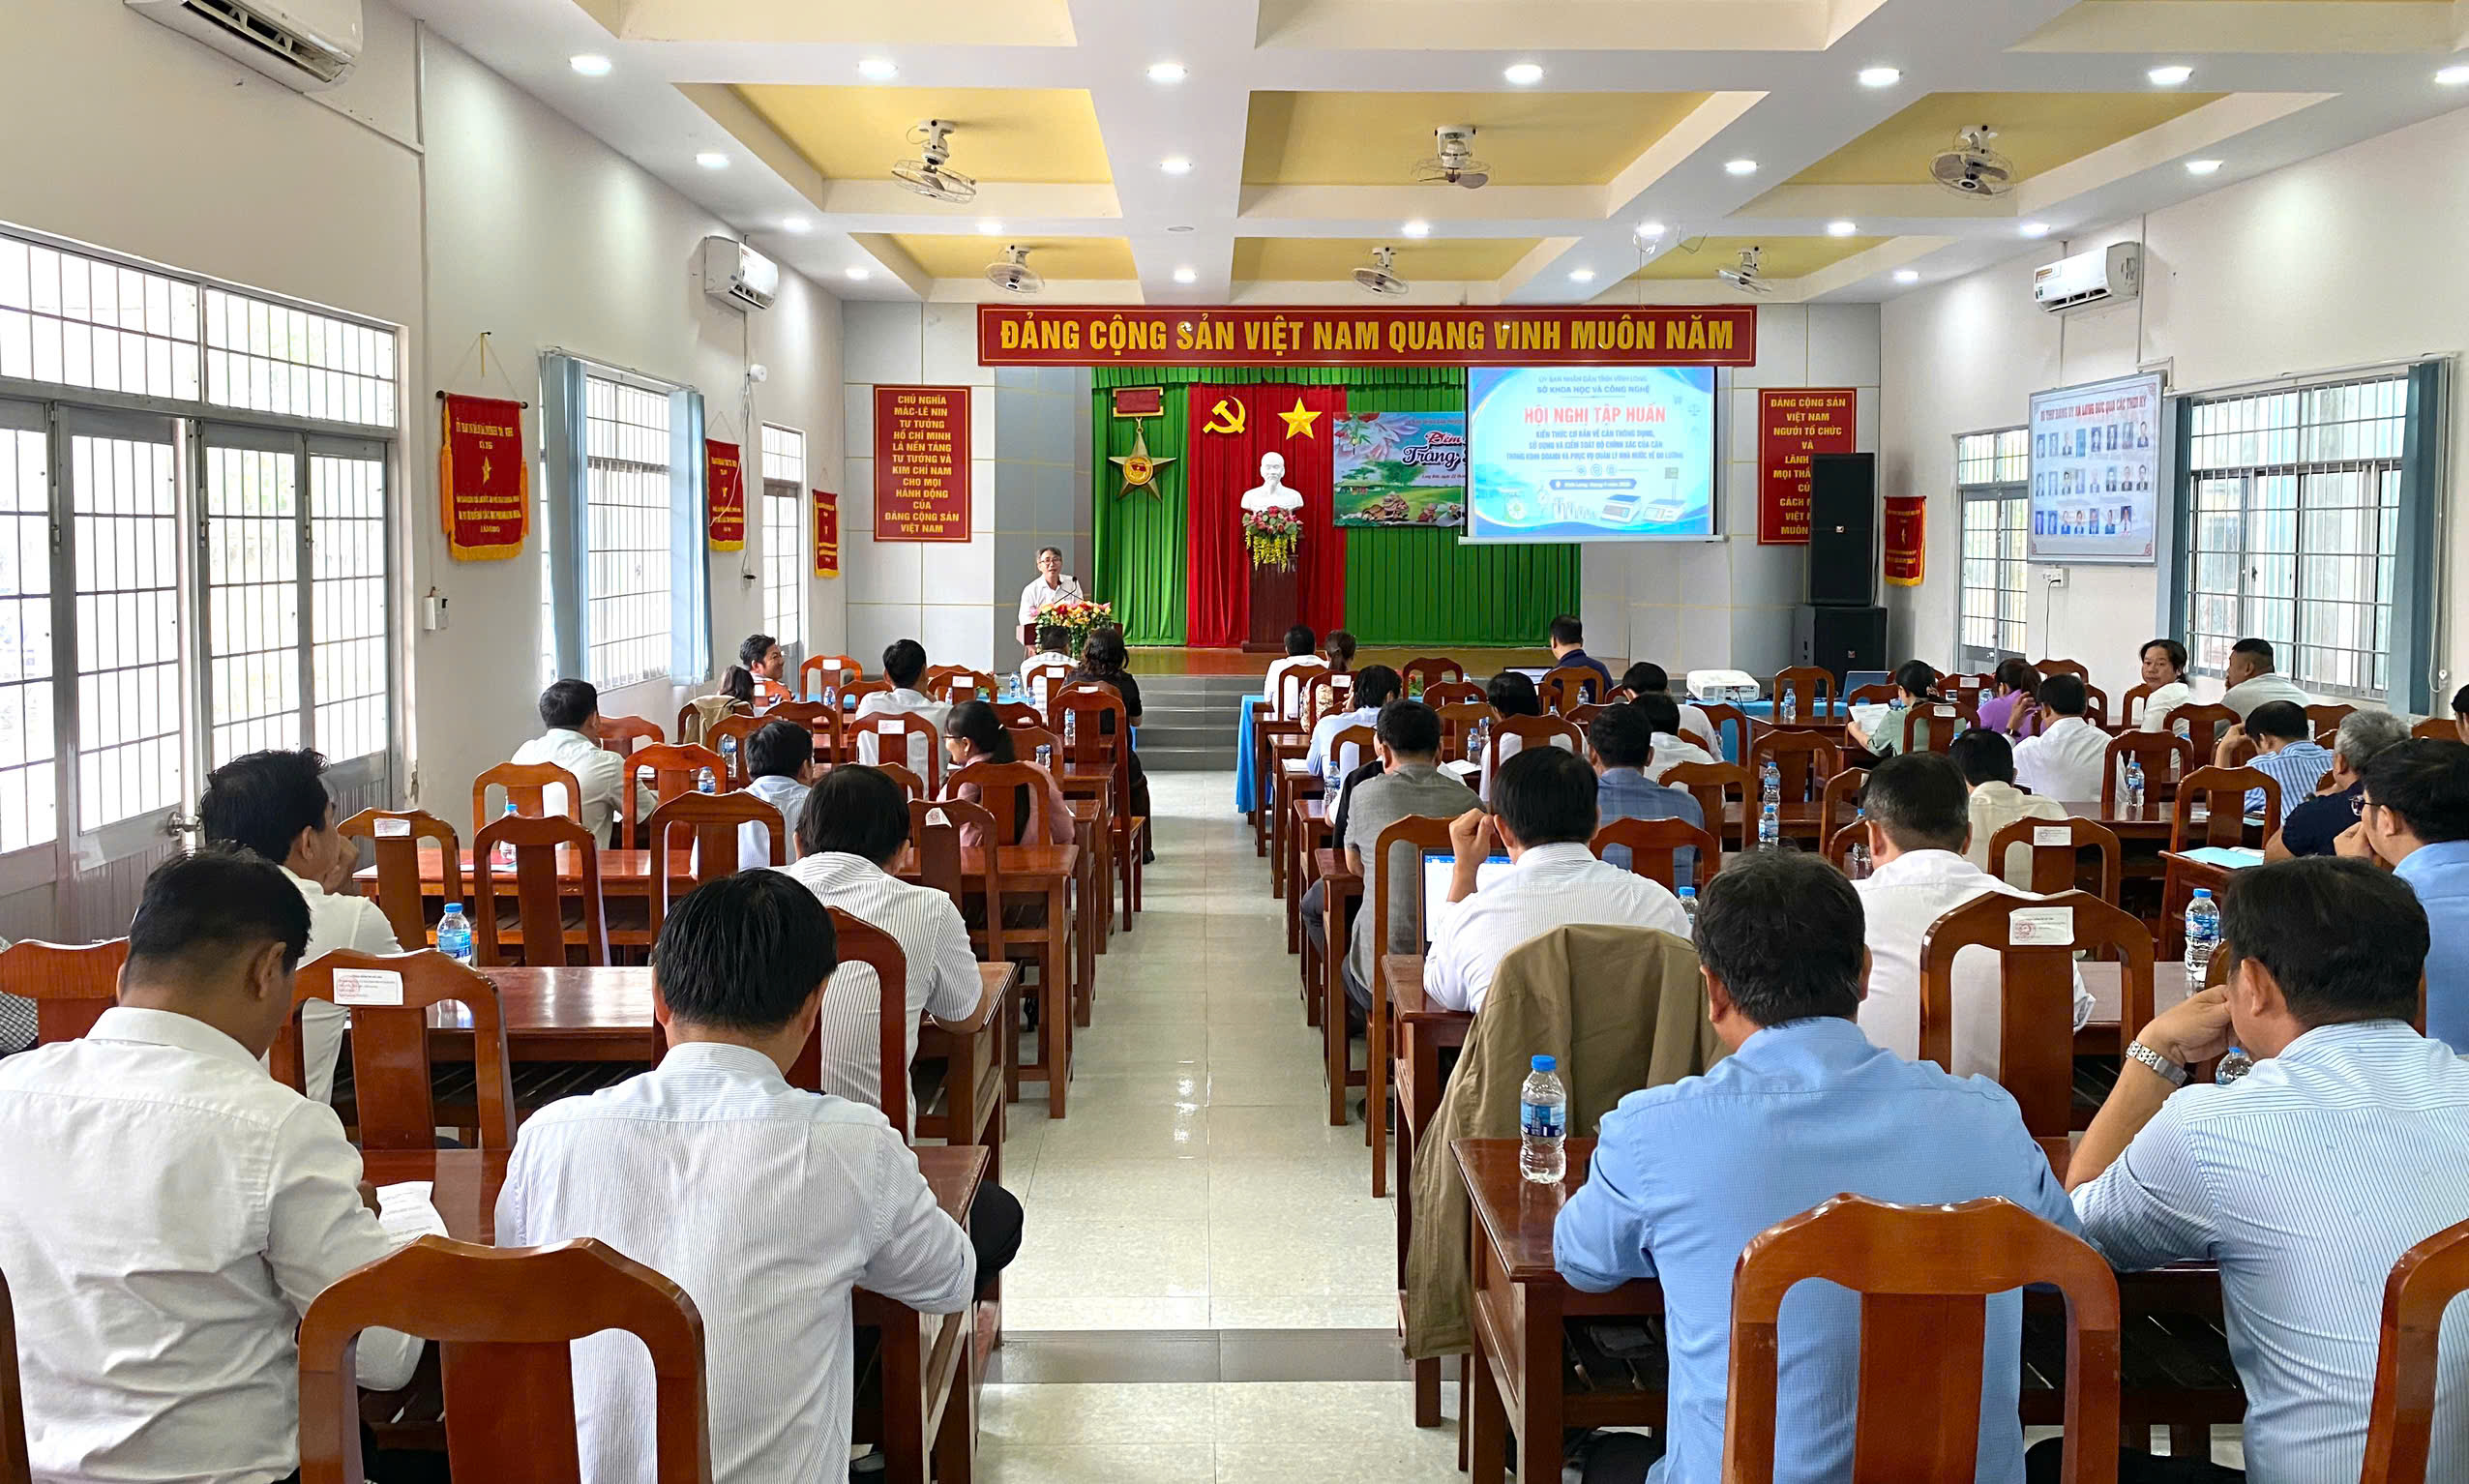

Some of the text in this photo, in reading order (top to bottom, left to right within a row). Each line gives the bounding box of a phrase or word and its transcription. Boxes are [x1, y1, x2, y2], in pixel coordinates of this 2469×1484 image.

[1000, 312, 1734, 356] ĐẢNG CỘNG SẢN VIỆT NAM QUANG VINH MUÔN NĂM
[1573, 386, 1591, 395] HỌC
[1604, 384, 1626, 393] CÔNG
[898, 395, 947, 404] CHỦ NGHĨA
[1770, 397, 1846, 408] ĐẢNG CỘNG SẢN
[1525, 401, 1666, 426] HỘI NGHỊ TẬP HUẤN
[1786, 411, 1829, 423] VIỆT NAM
[900, 418, 944, 429] TƯ TƯỞNG
[893, 429, 906, 439] HỒ
[1773, 425, 1802, 435] NGƯỜI
[1818, 425, 1842, 435] CHỨC
[928, 442, 952, 452] TẢNG
[1801, 439, 1814, 449] VÀ
[892, 453, 952, 463] TƯ TƯỞNG VÀ
[1785, 454, 1809, 464] LÃNH
[892, 466, 910, 475] KIM
[931, 467, 952, 476] NAM
[1773, 466, 1811, 480] MỌI THẮ
[903, 478, 941, 488] CHO MỌI
[1798, 482, 1810, 491] CỦ
[896, 488, 948, 498] HÀNH ĐỘNG
[913, 499, 932, 510] CỦA
[1779, 496, 1804, 506] CÁCH
[884, 511, 960, 522] ĐẢNG CỘNG SẢN
[1785, 511, 1803, 521] VIỆT
[901, 522, 943, 534] VIỆT NAM
[1781, 524, 1808, 534] MUÔN
